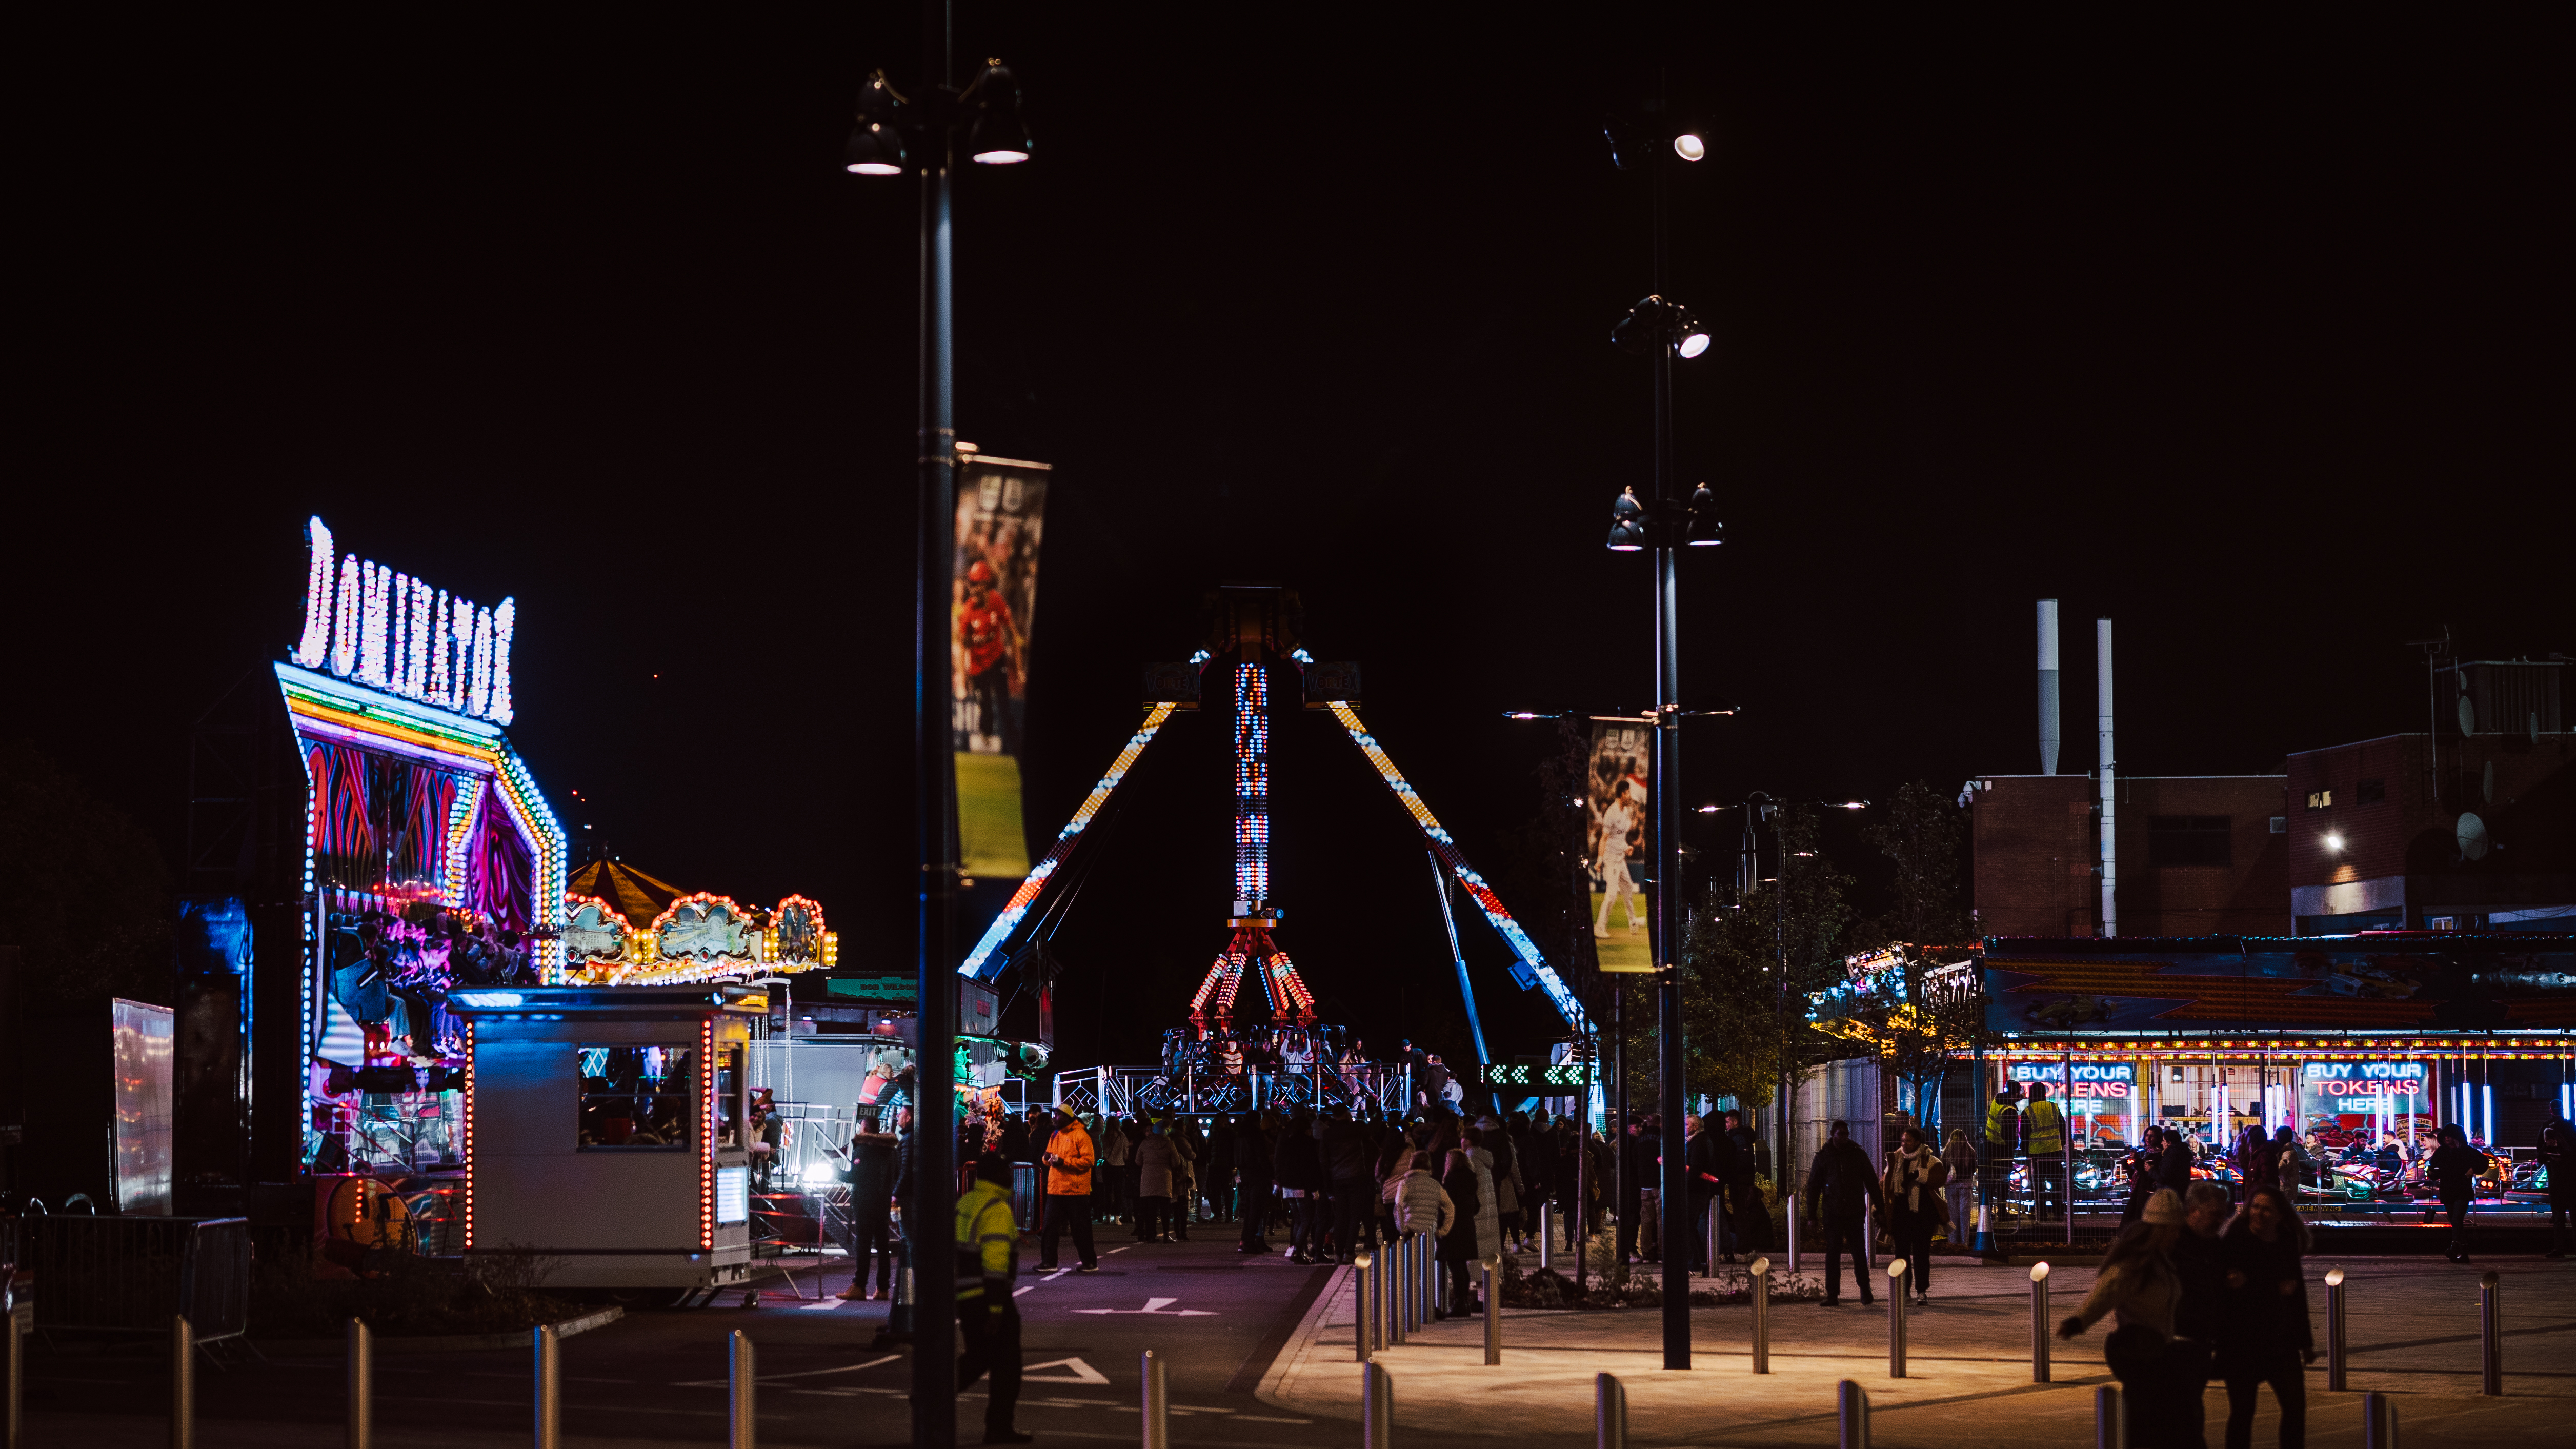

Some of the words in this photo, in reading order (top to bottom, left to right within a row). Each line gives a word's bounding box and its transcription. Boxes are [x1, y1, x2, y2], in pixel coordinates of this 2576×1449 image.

[1146, 672, 1196, 692] VORTEX
[1306, 671, 1358, 692] VORTEX
[2017, 1066, 2062, 1080] BUY
[2070, 1066, 2131, 1080] YOUR
[2307, 1064, 2352, 1078] BUY
[2361, 1064, 2422, 1078] YOUR
[2311, 1079, 2419, 1096] TOKENS
[859, 1107, 877, 1116] EXIT
